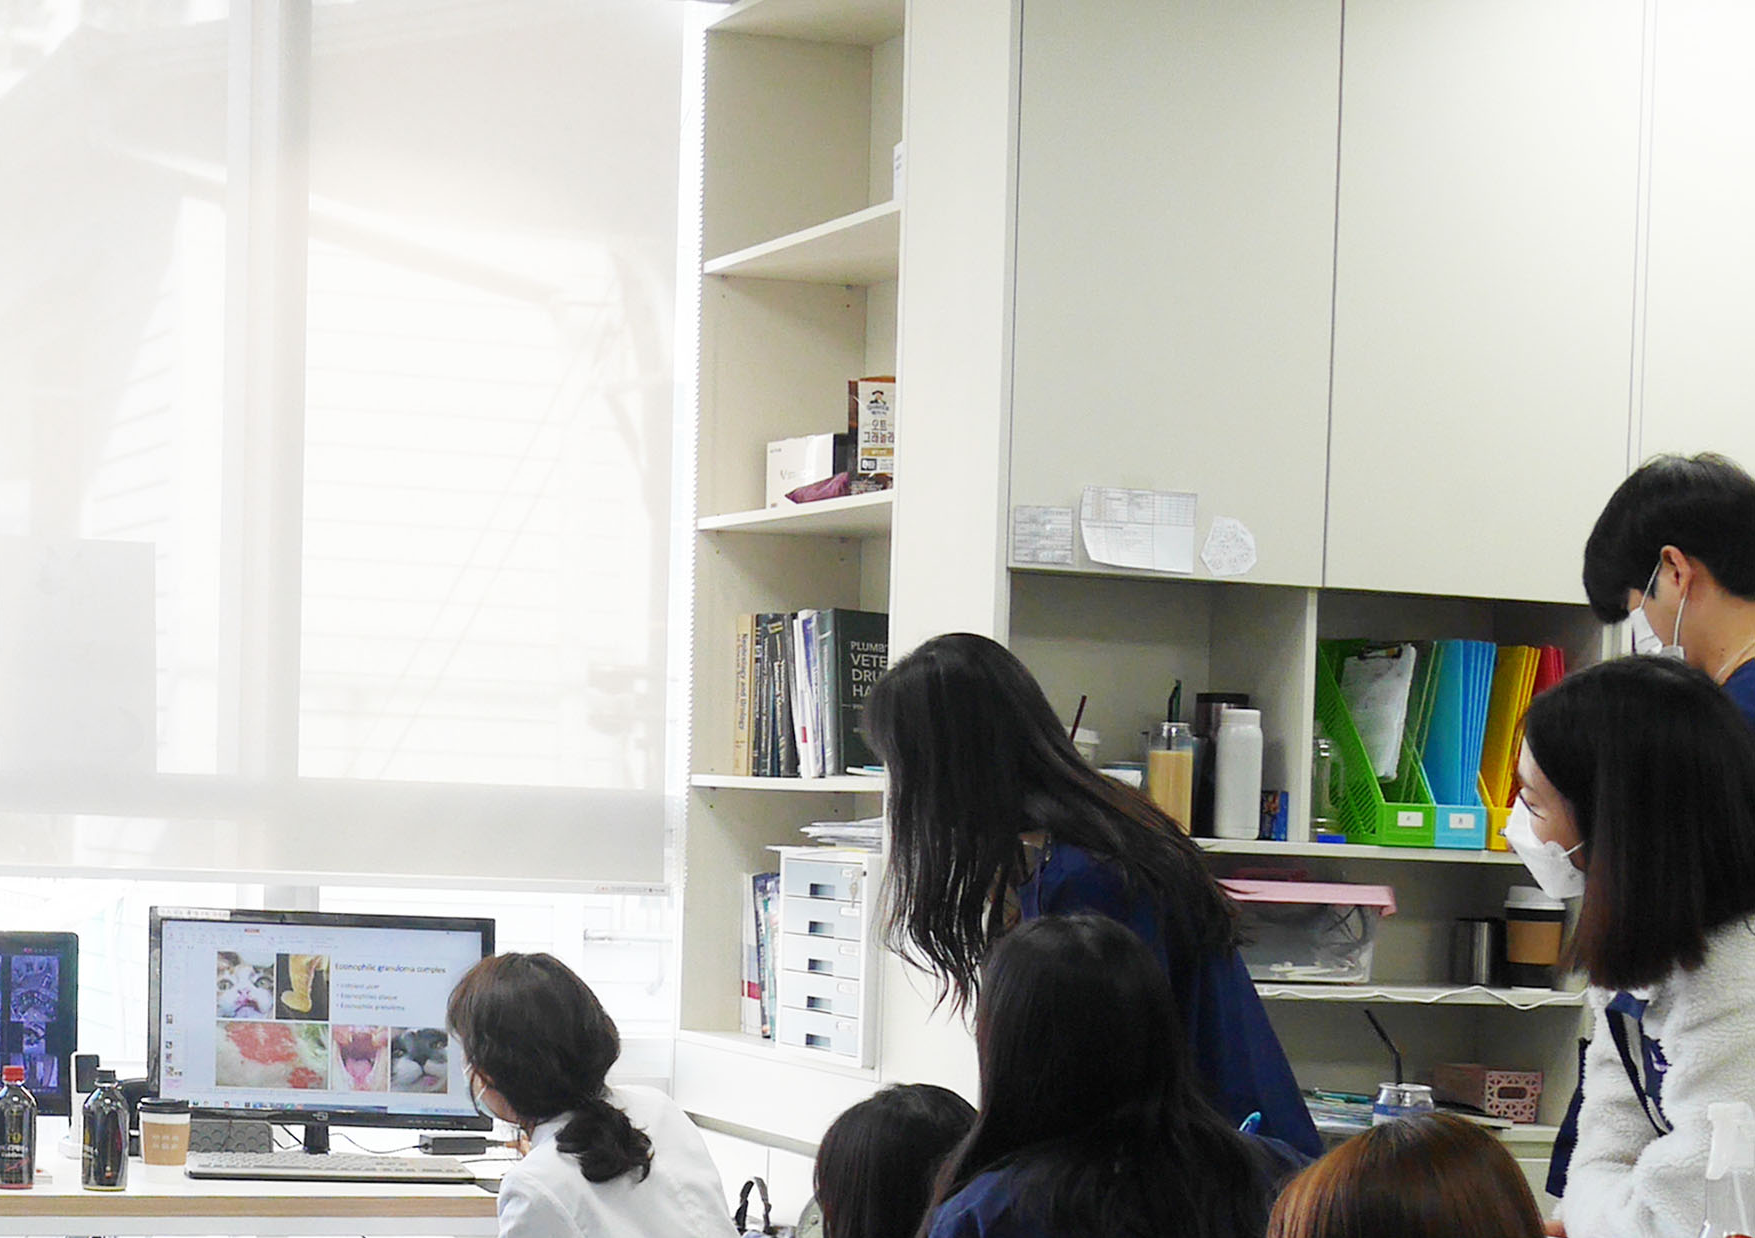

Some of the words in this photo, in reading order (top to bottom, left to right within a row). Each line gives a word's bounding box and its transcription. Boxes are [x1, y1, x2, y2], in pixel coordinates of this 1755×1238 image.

[851, 642, 888, 652] PLUMB'
[851, 655, 888, 667] VETE
[851, 669, 883, 682] DRU
[852, 684, 872, 698] HA
